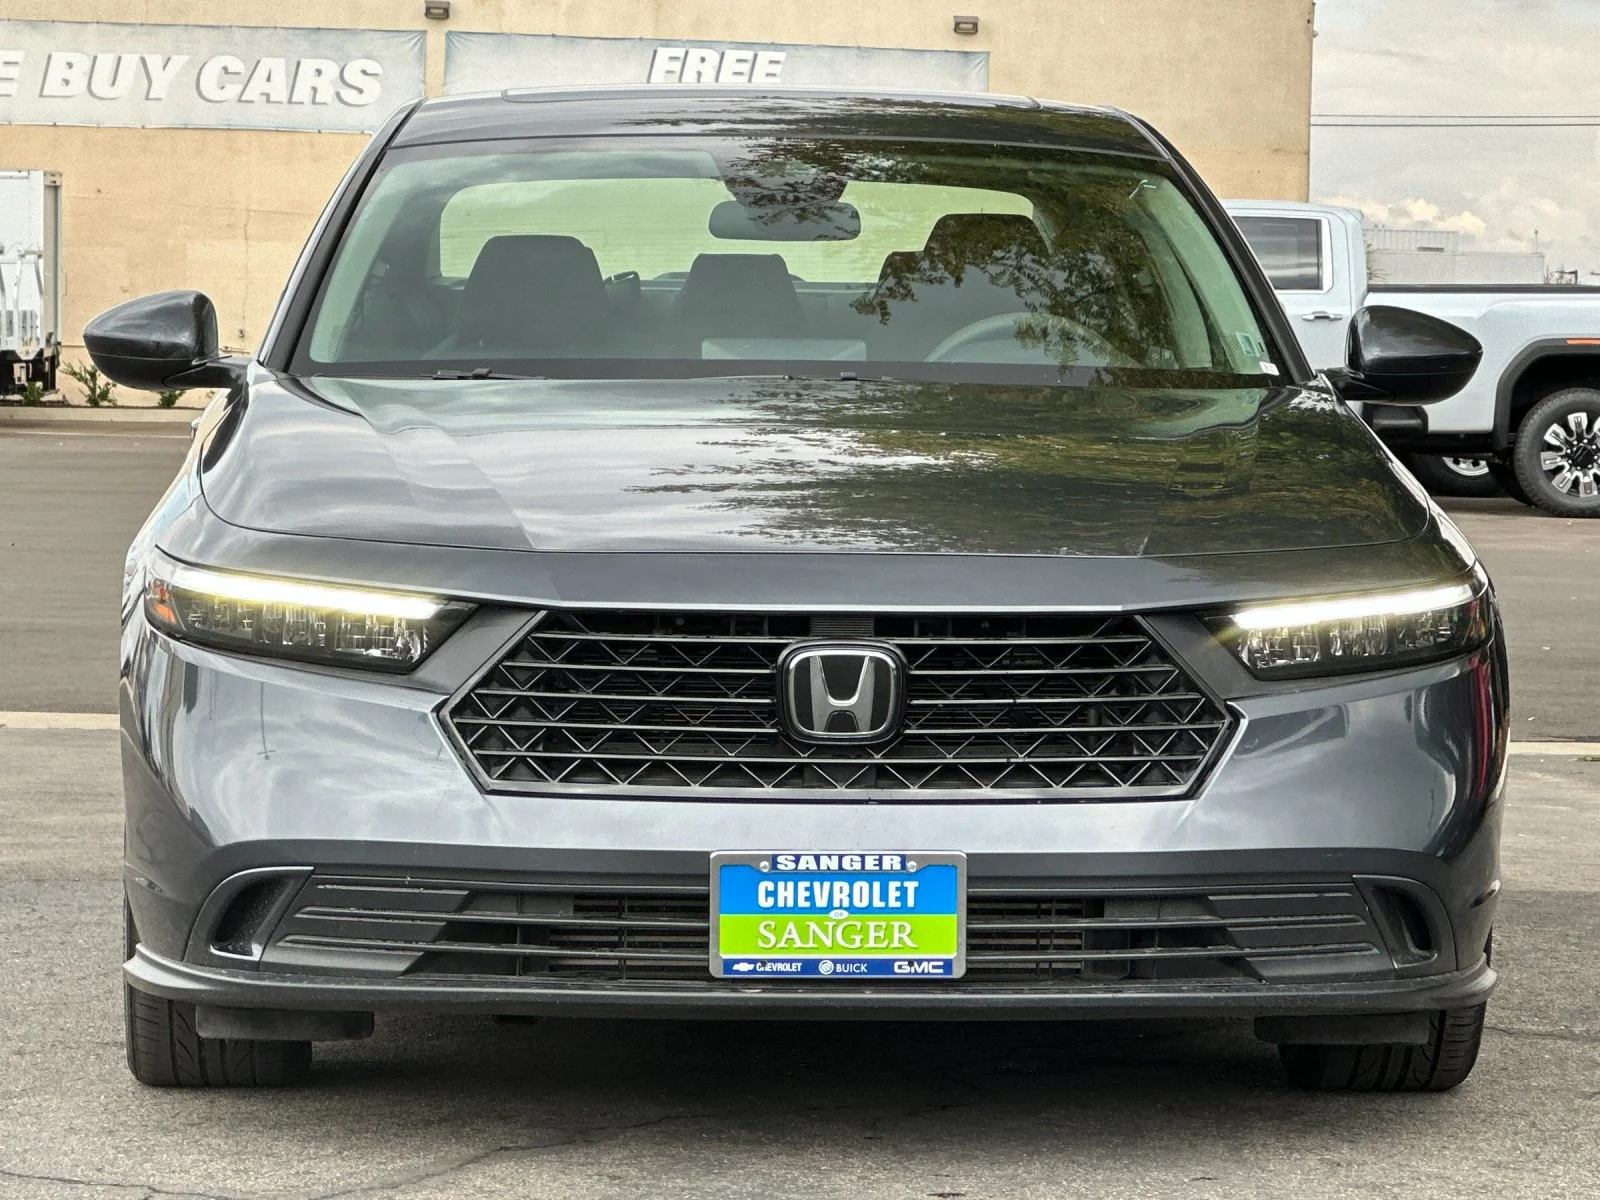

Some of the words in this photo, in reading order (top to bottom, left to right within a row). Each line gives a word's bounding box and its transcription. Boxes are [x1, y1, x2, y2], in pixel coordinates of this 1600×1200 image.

[647, 47, 787, 83] FREE
[39, 52, 190, 100] BUY
[196, 55, 384, 107] CARS
[776, 855, 902, 871] SANGER
[757, 881, 919, 908] CHEVROLET
[757, 920, 918, 949] SANGER
[836, 963, 867, 973] BUICK
[894, 961, 944, 974] GMC
